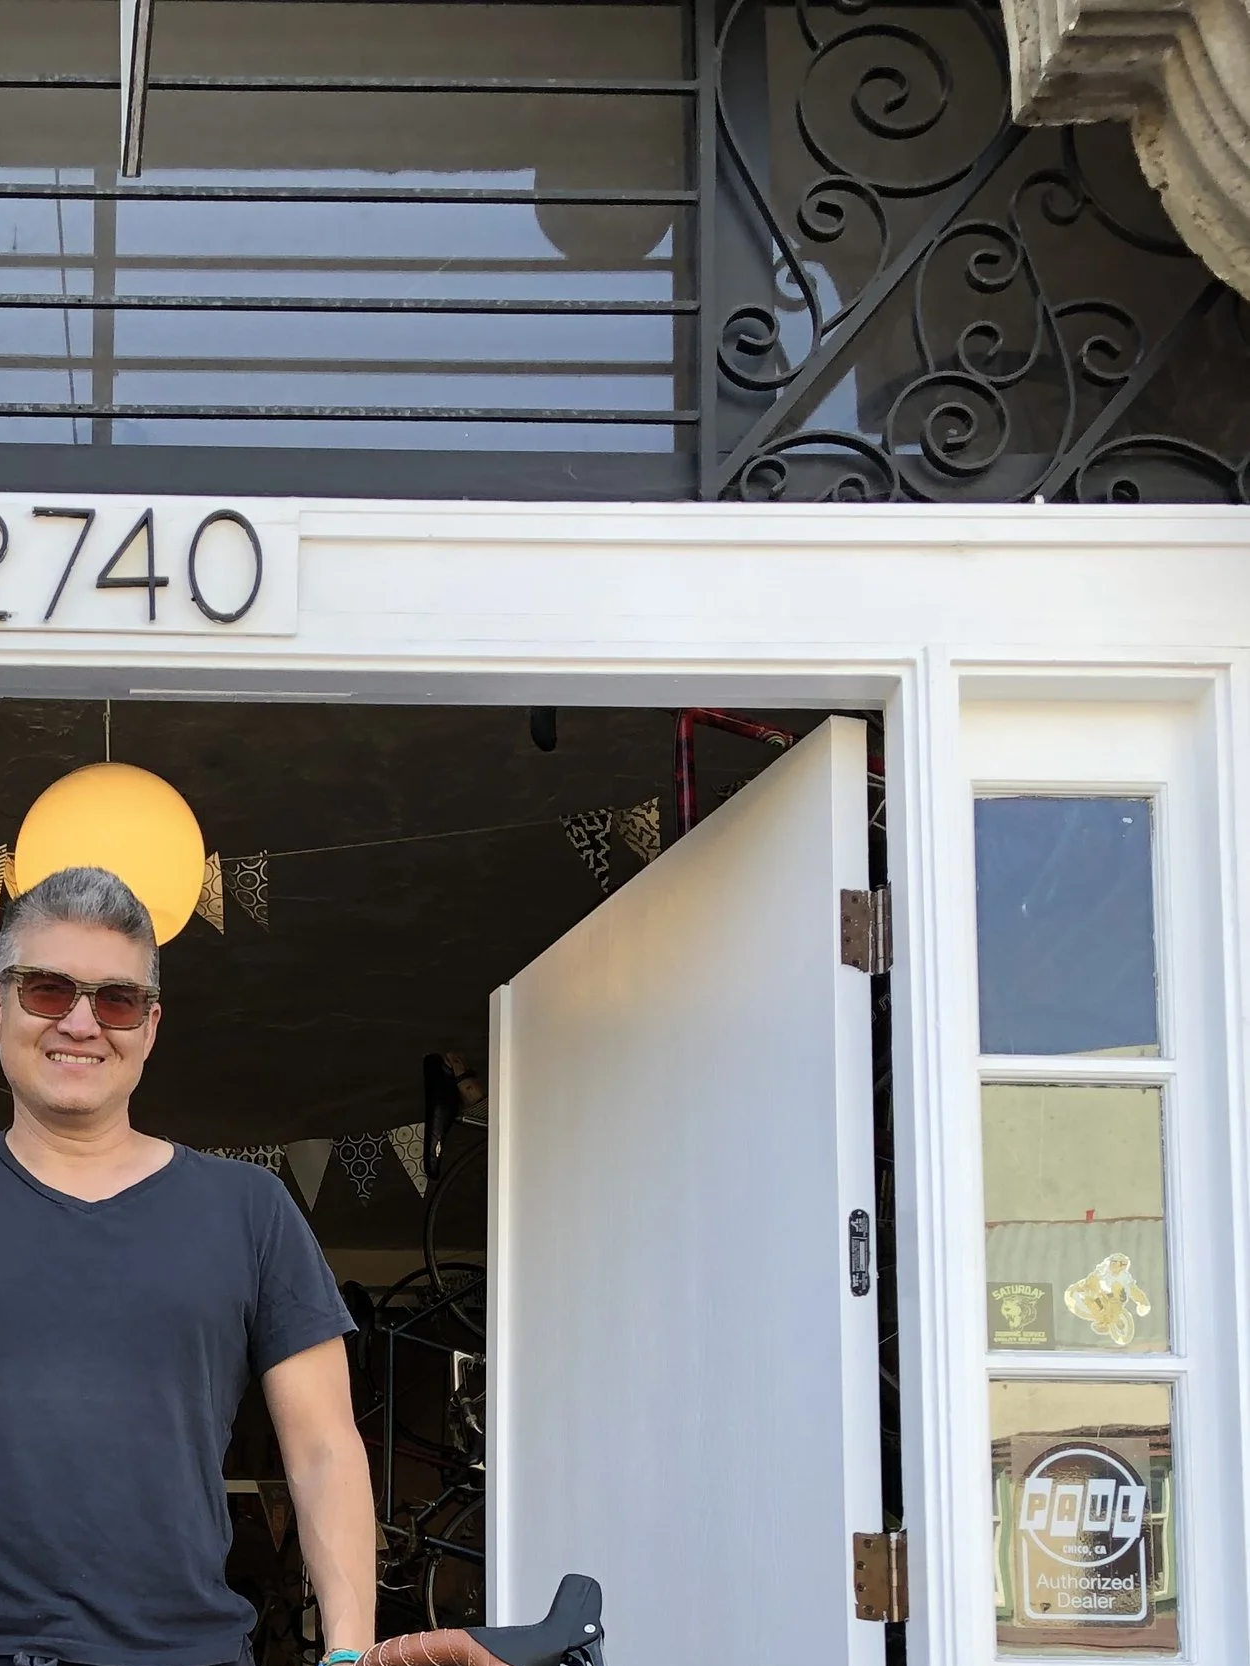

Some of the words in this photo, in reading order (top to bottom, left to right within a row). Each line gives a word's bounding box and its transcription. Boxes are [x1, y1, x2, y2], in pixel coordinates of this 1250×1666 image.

[992, 1284, 1045, 1300] SATURDAY
[1020, 1482, 1145, 1534] PAUL
[1063, 1545, 1092, 1555] CHICO,
[1094, 1545, 1107, 1555] CA
[1036, 1574, 1134, 1591] Authorized
[1057, 1592, 1116, 1609] Dealer
